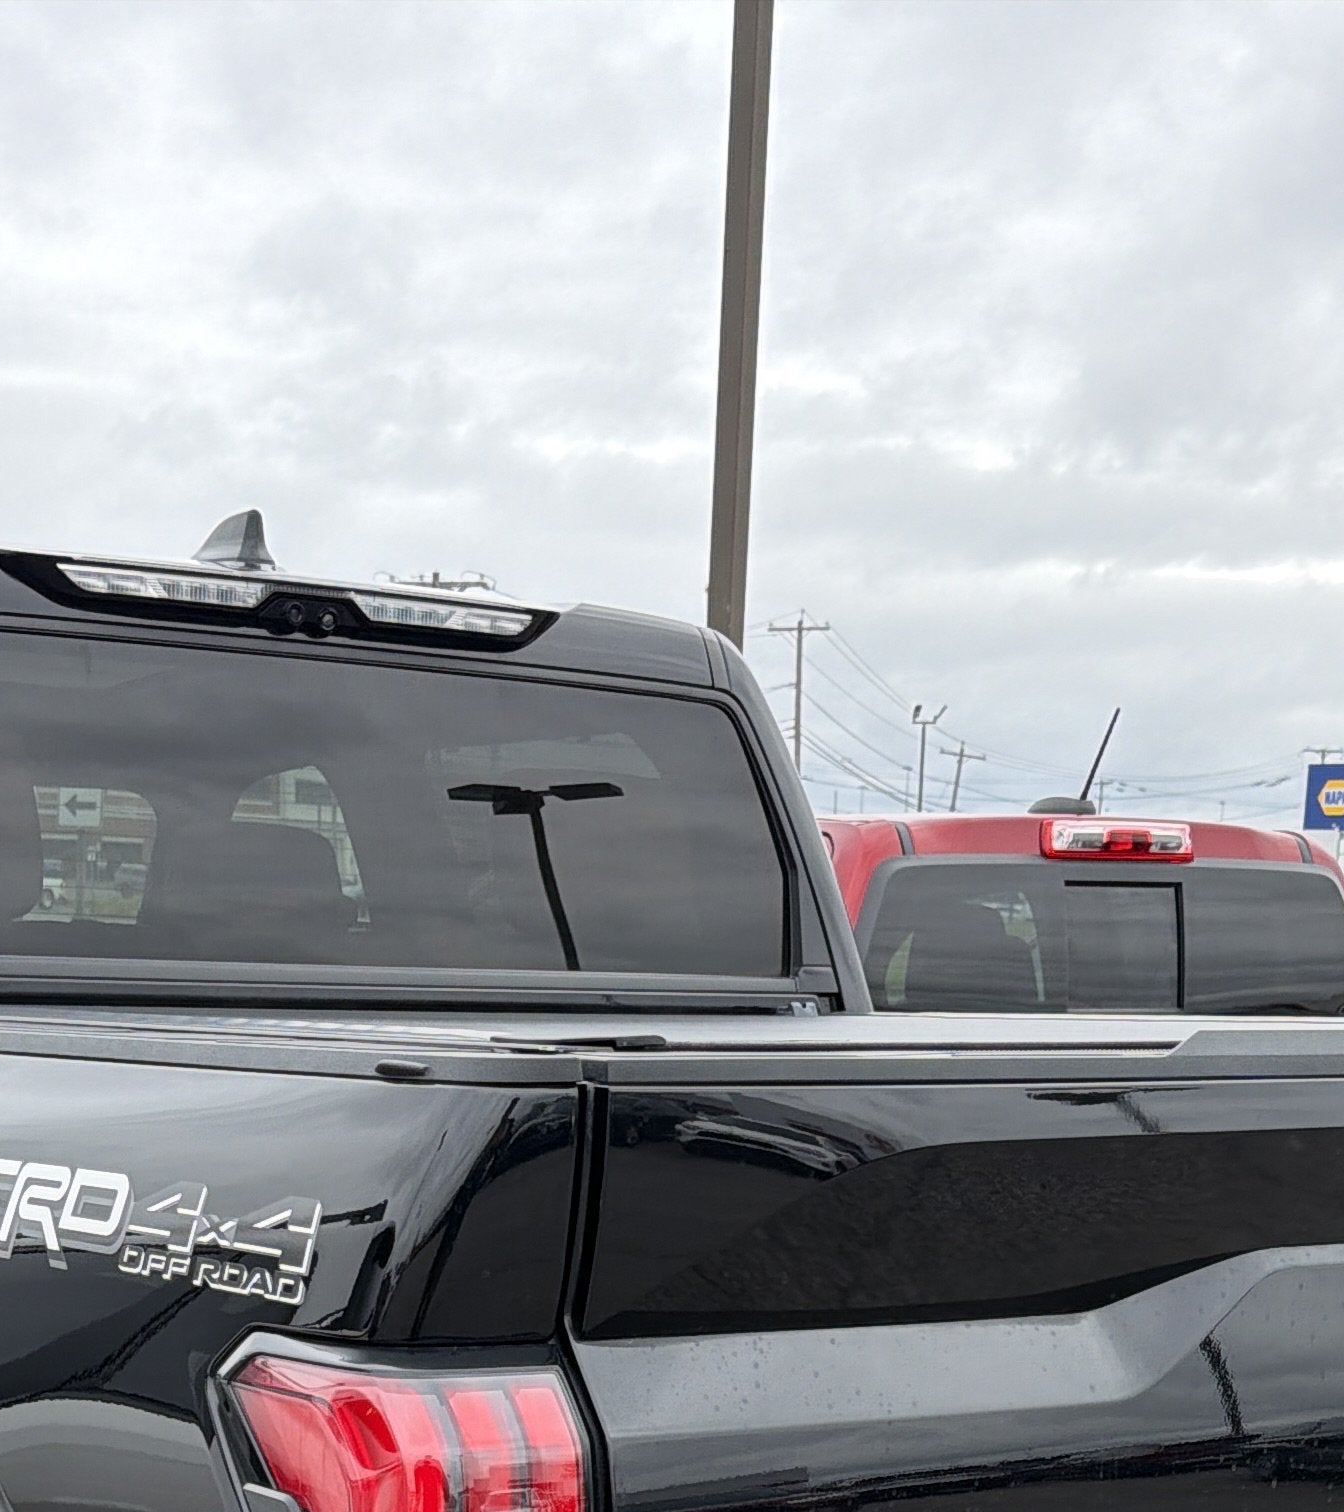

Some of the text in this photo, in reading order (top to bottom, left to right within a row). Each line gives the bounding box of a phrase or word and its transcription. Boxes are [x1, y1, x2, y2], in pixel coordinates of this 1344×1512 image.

[128, 1180, 322, 1276] 4x4
[119, 1245, 307, 1307] OFF ROAD
